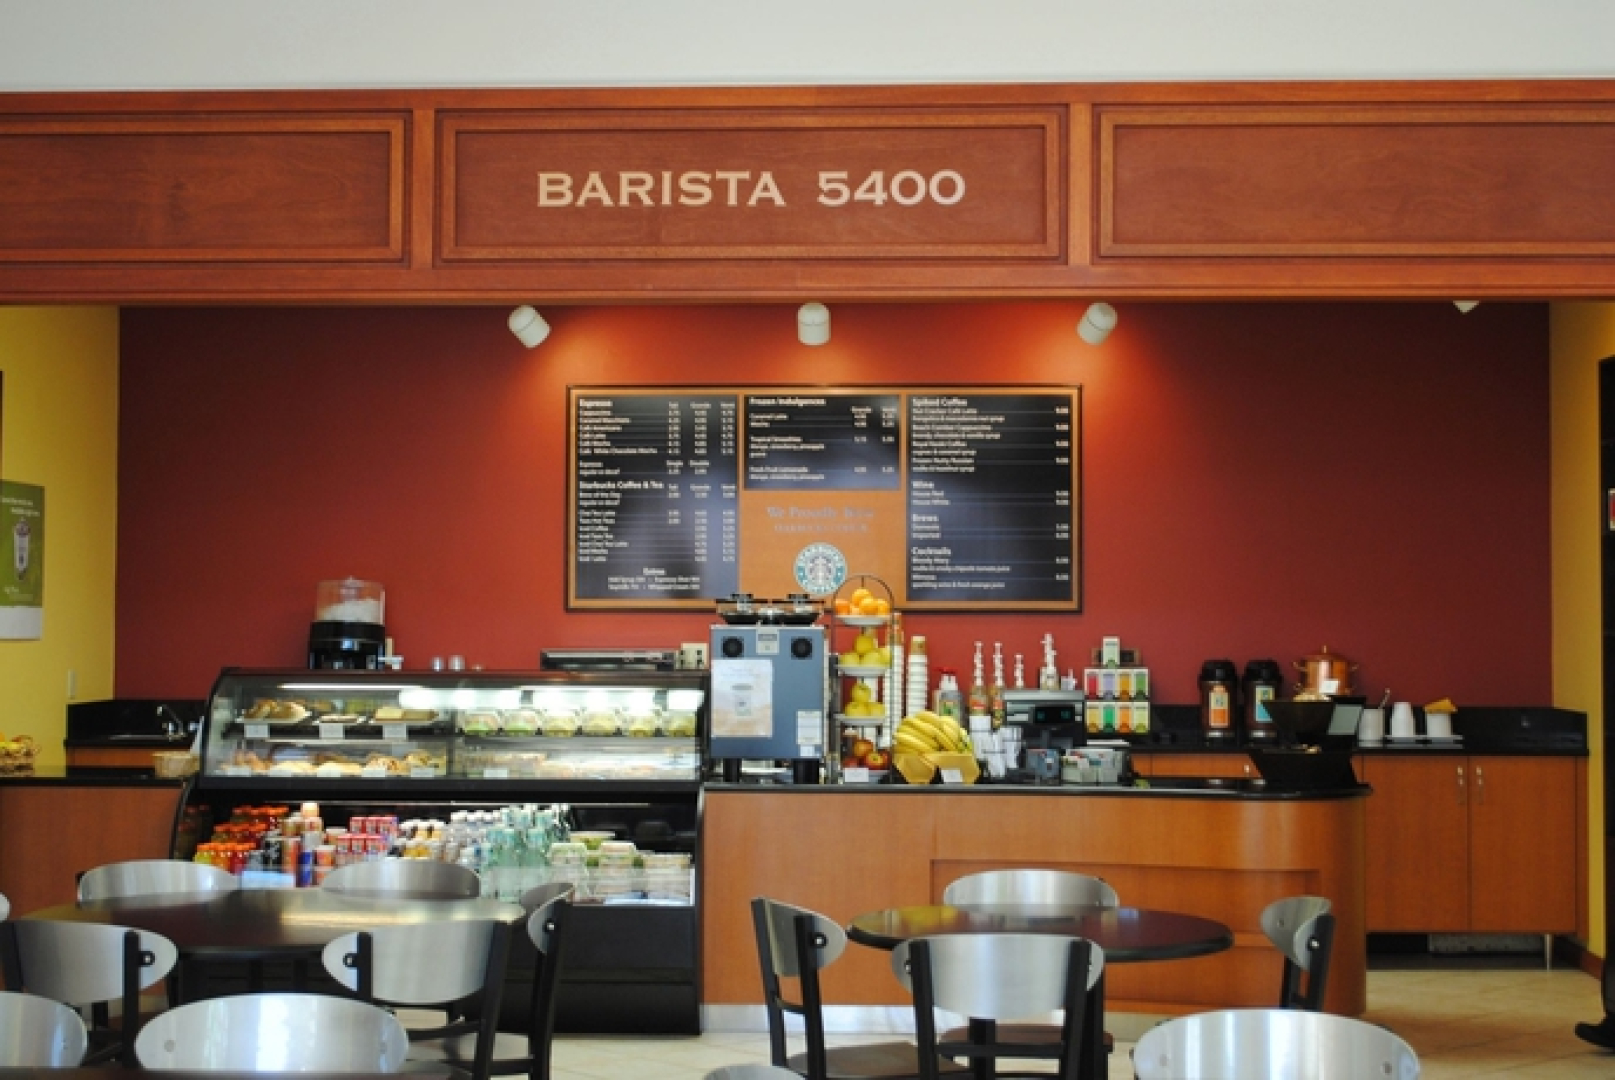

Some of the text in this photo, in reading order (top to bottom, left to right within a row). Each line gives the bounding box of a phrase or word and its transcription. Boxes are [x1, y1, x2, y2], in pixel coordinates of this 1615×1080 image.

[536, 169, 966, 209] BARISTA 5400
[941, 398, 967, 407] Coffee
[617, 481, 641, 489] Coffee
[649, 481, 664, 489] Tea
[912, 481, 934, 489] Wine
[767, 506, 784, 517] We
[789, 506, 837, 517] Proudly
[911, 547, 951, 555] Cocktails
